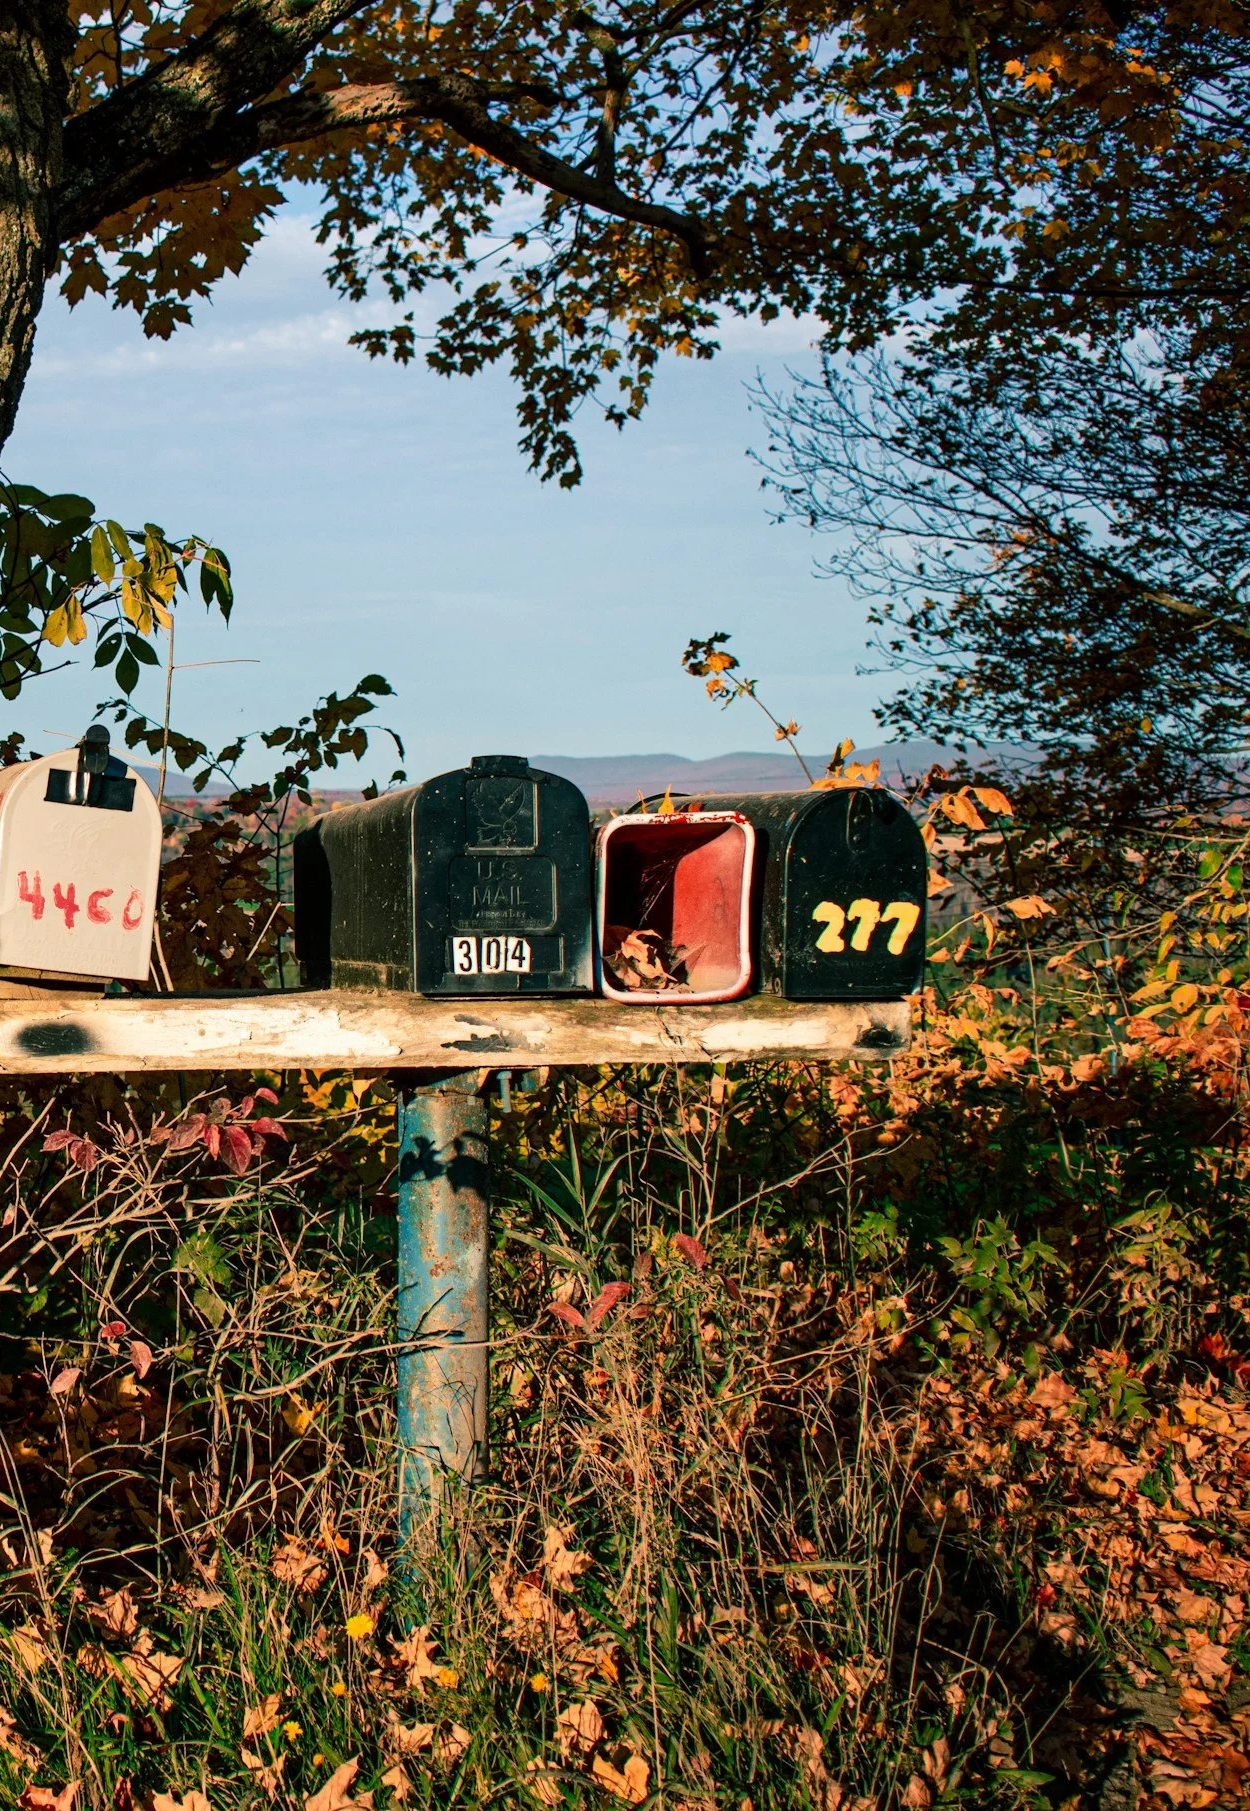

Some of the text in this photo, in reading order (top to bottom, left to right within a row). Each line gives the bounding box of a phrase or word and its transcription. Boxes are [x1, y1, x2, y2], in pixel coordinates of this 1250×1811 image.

[471, 884, 531, 907] MAIL
[811, 897, 921, 956] 277
[457, 937, 527, 973] 304
